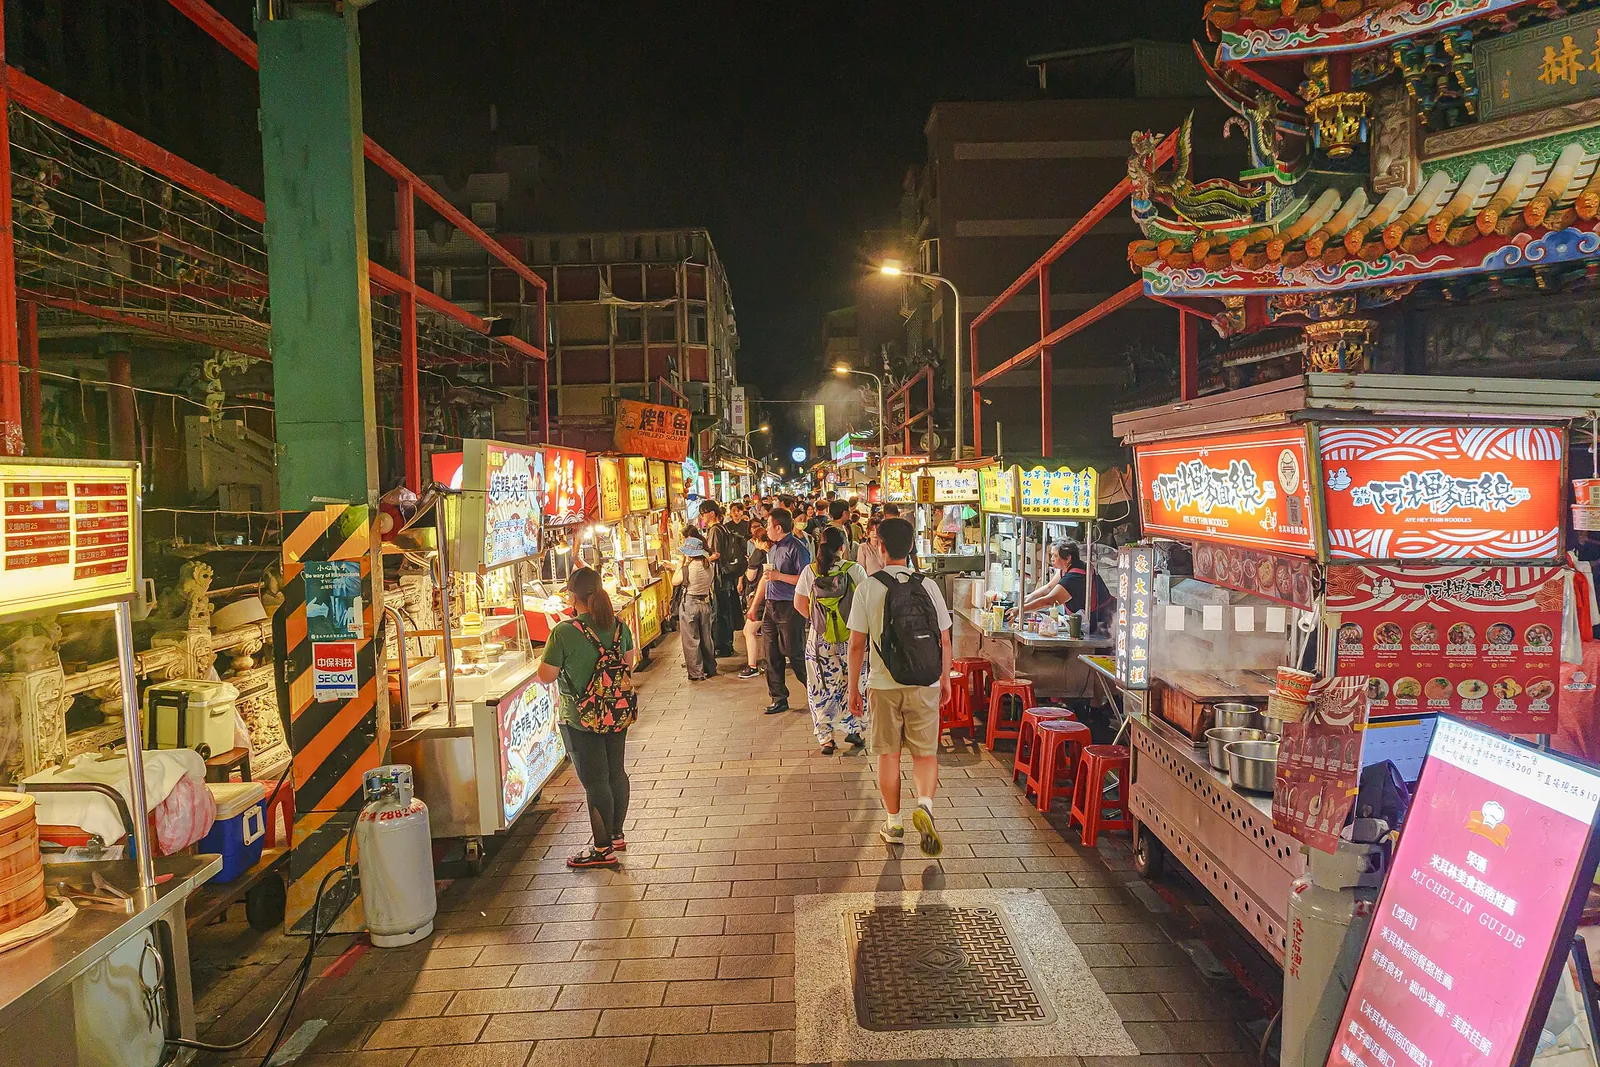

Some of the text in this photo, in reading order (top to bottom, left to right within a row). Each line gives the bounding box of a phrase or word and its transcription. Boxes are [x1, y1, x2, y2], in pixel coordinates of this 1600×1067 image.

[637, 431, 664, 439] GRILLED
[1369, 471, 1517, 514] 阿輝麵線
[26, 504, 33, 512] 25
[30, 522, 38, 530] 25
[1209, 518, 1229, 527] NOODLES
[25, 538, 33, 546] 25
[1423, 578, 1505, 602] 阿輝麵線
[1130, 554, 1149, 684] 豪大支豬血糕
[317, 658, 353, 668] 中保科技
[318, 674, 353, 683] SECOM
[1465, 850, 1489, 874] 榮獲
[1429, 853, 1519, 917] 米其林美食指南推薦
[1410, 868, 1526, 949] MICHELIN GUIDE
[1380, 925, 1455, 991] 米其林指南餐盤推薦
